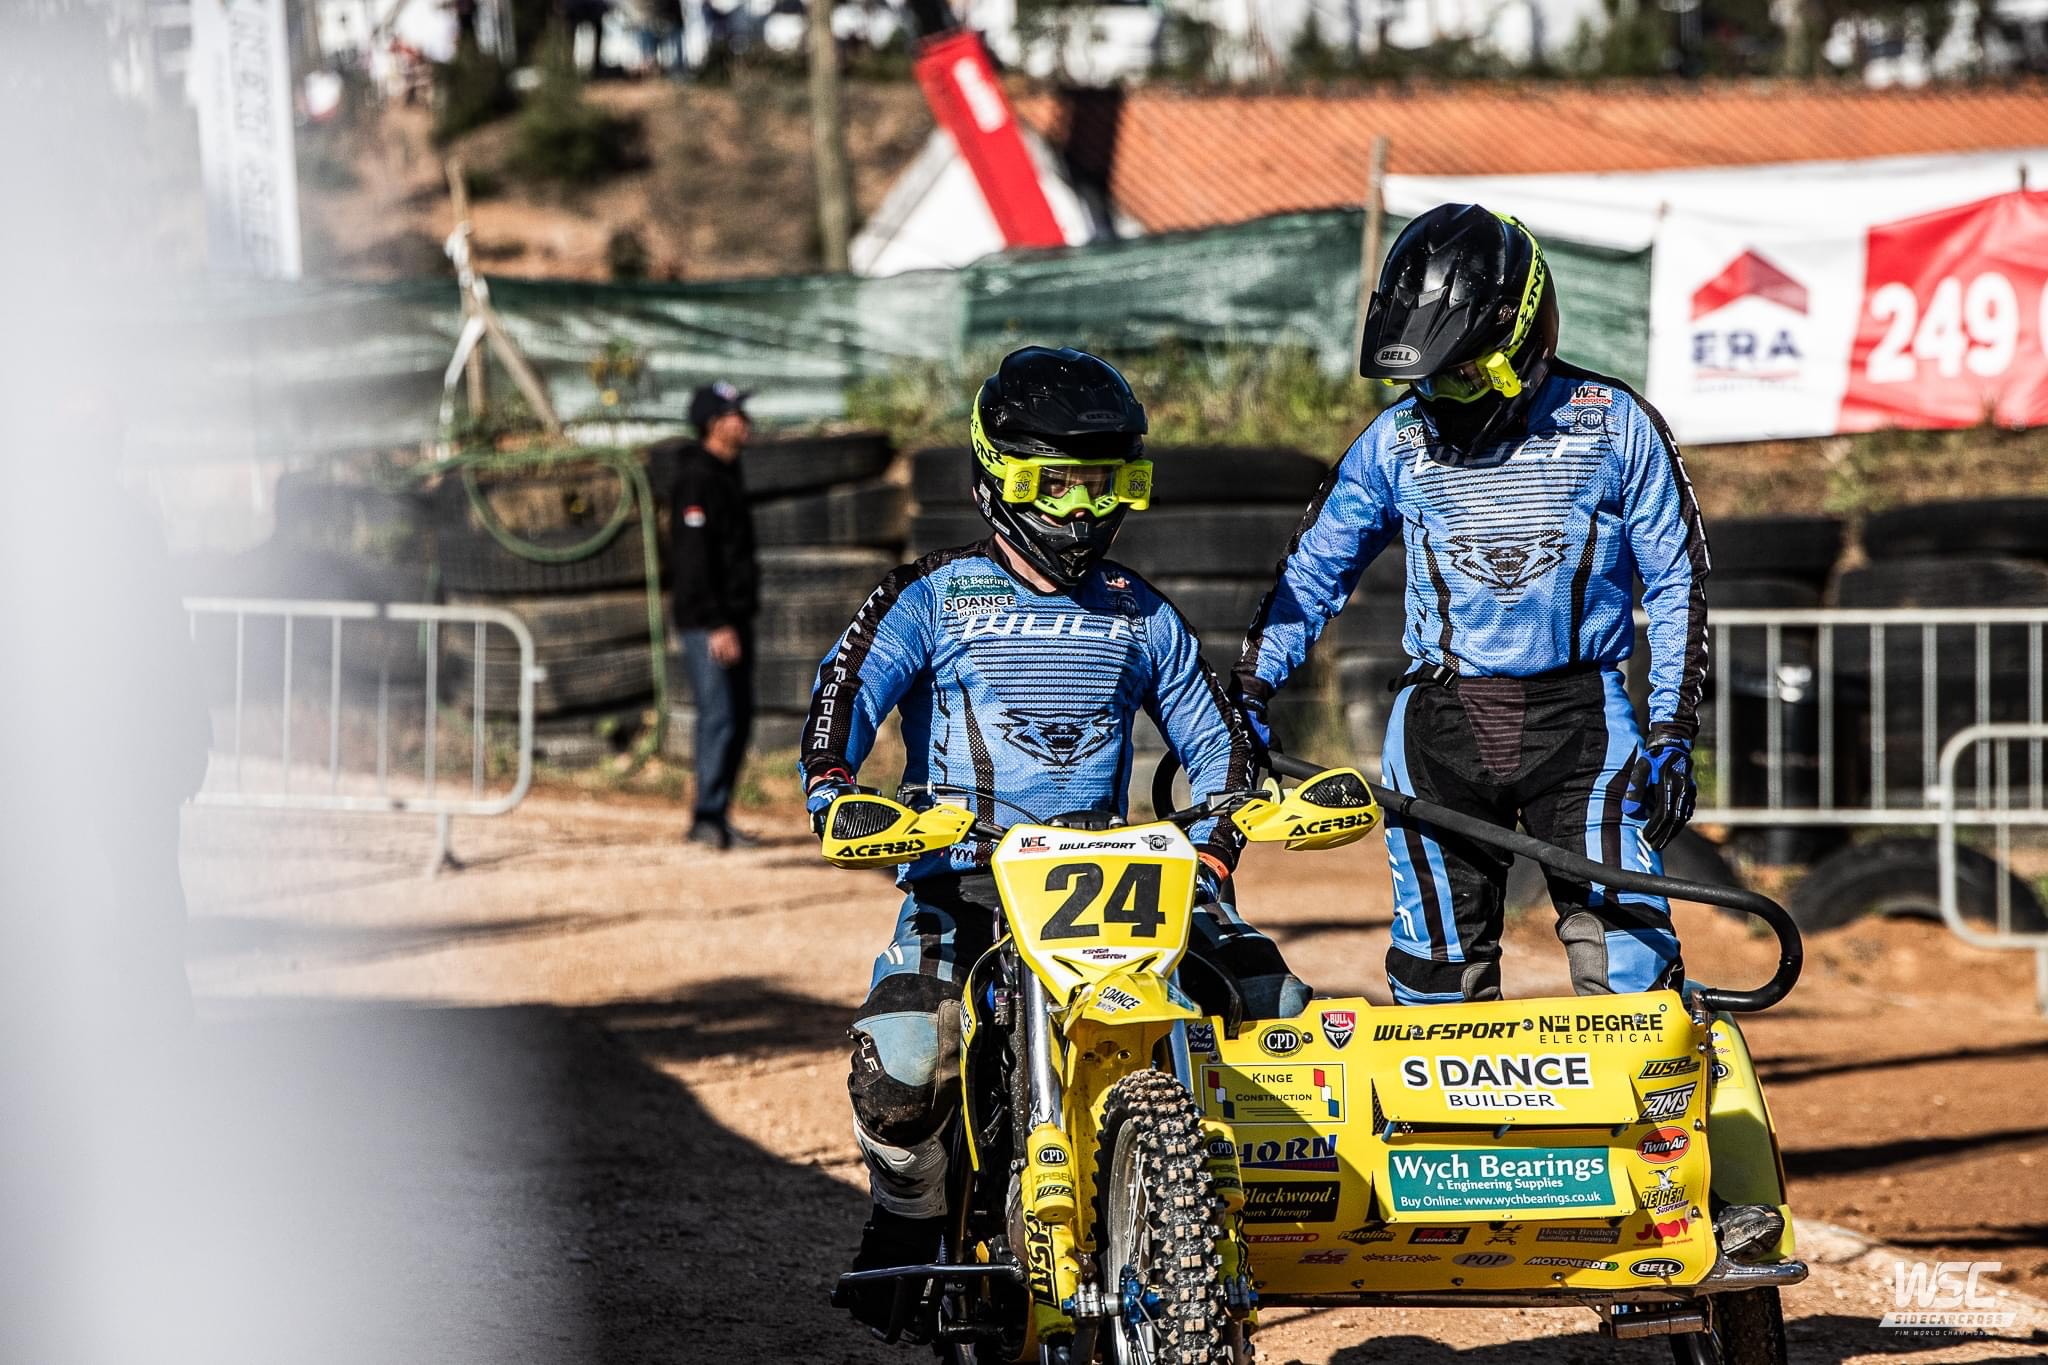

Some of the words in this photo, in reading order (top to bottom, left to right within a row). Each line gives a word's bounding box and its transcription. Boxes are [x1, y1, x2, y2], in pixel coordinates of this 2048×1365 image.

[1865, 273, 2020, 384] 249
[1692, 331, 1802, 364] ERA
[1380, 350, 1412, 361] BELL
[1580, 413, 1602, 425] FIM
[944, 600, 952, 612] S
[956, 595, 1016, 611] DANCE
[958, 608, 1003, 620] BUILDER
[1288, 811, 1375, 838] ACERBIS
[836, 839, 926, 858] ACERBIS
[1021, 836, 1046, 848] WSC
[1059, 842, 1137, 851] WULFSPORT
[1040, 862, 1166, 941] 24
[1103, 987, 1140, 1010] DANCE
[1329, 1012, 1348, 1025] BULL
[1576, 1013, 1664, 1033] DEGREE
[1373, 1021, 1521, 1042] WULFSPORT
[1540, 1032, 1664, 1044] ELECTRICAL
[1266, 1032, 1297, 1050] CPD
[1405, 1060, 1428, 1086] S
[1440, 1056, 1589, 1087] DANCE
[1449, 1094, 1555, 1107] BUILDER
[1641, 1089, 1693, 1117] AMS
[1209, 1142, 1232, 1155] CPD
[1041, 1150, 1065, 1163] CPD
[1392, 1154, 1470, 1185] Wych
[1479, 1153, 1605, 1181] Bearings
[1437, 1182, 1444, 1190] &
[1447, 1178, 1513, 1192] Engineering
[1514, 1177, 1564, 1190] Supplies
[1400, 1196, 1420, 1208] Buy
[1423, 1196, 1462, 1207] Online:
[1463, 1191, 1602, 1208] www.wychbearings.co.uk
[1640, 1186, 1685, 1209] REIGER
[1270, 1208, 1312, 1221] Therapy
[1259, 1234, 1305, 1242] Racing
[1339, 1231, 1396, 1240] Putoline
[1579, 1228, 1618, 1237] Brothers
[1462, 1255, 1508, 1266] POP
[1529, 1256, 1607, 1270] MOTOVERDE
[1637, 1264, 1676, 1273] BELL
